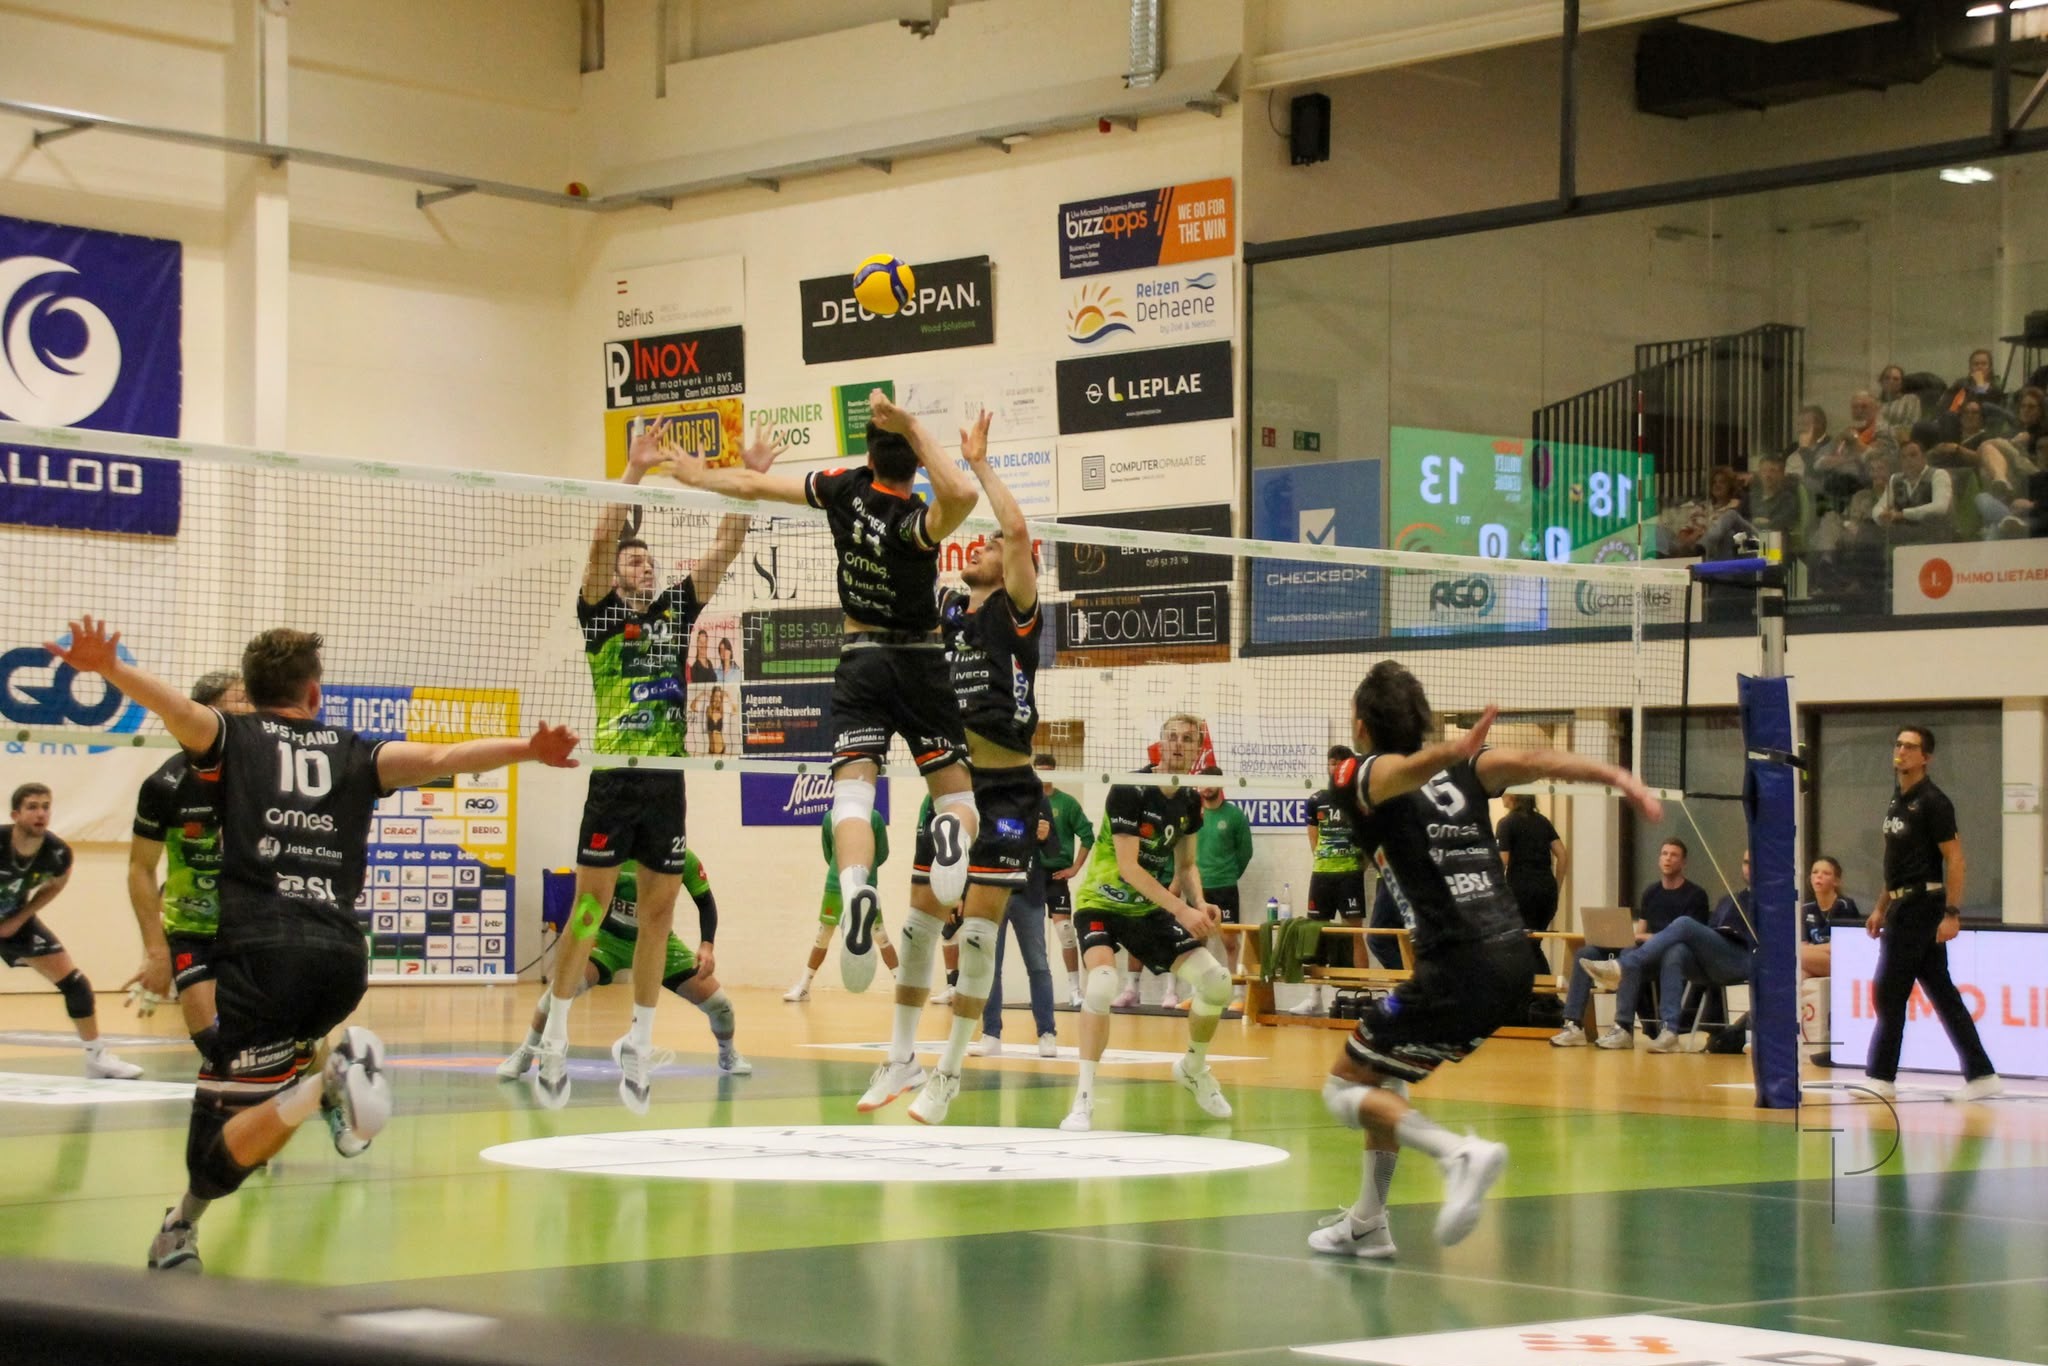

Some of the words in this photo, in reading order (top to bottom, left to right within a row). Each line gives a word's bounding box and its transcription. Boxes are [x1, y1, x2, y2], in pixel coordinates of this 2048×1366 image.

[1178, 204, 1192, 220] WE
[1193, 202, 1205, 218] GO
[1207, 199, 1225, 215] FOR
[1066, 210, 1148, 240] bizzapps
[1178, 221, 1200, 244] THE
[1203, 218, 1226, 241] WIN
[1136, 280, 1179, 299] Reizen
[812, 282, 981, 328] DESPAN.
[1137, 296, 1215, 322] Dehaene
[617, 308, 654, 329] Belfius
[943, 320, 976, 332] Solutions
[633, 339, 700, 381] INOX
[650, 381, 657, 390] &
[660, 376, 701, 388] maatwerk
[705, 374, 713, 383] in
[716, 372, 732, 382] RVS
[700, 387, 716, 397] 0474
[717, 384, 729, 395] 500
[730, 382, 742, 393] 245
[1128, 372, 1202, 400] LEPLAE
[750, 403, 823, 427] FOURNIER
[1003, 451, 1051, 468] DELCROIX
[1266, 568, 1368, 586] CHECKBOX
[1957, 571, 1993, 585] IMMO
[1070, 606, 1213, 644] DECOMBLE
[955, 670, 989, 681] IVECO
[745, 694, 783, 707] Algemene
[353, 697, 465, 734] DECOSPAN
[278, 740, 332, 798] 10
[793, 803, 828, 817] APÉRITIFS
[1226, 800, 1306, 824] WERKE
[1328, 807, 1341, 822] 14
[383, 827, 418, 836] CRACK
[1163, 824, 1175, 846] 9
[285, 843, 313, 856] Jette
[315, 846, 343, 860] Clean
[672, 836, 686, 853] 22
[1347, 898, 1356, 908] 14
[1222, 909, 1231, 919] 12
[1851, 978, 1987, 1022] IMO
